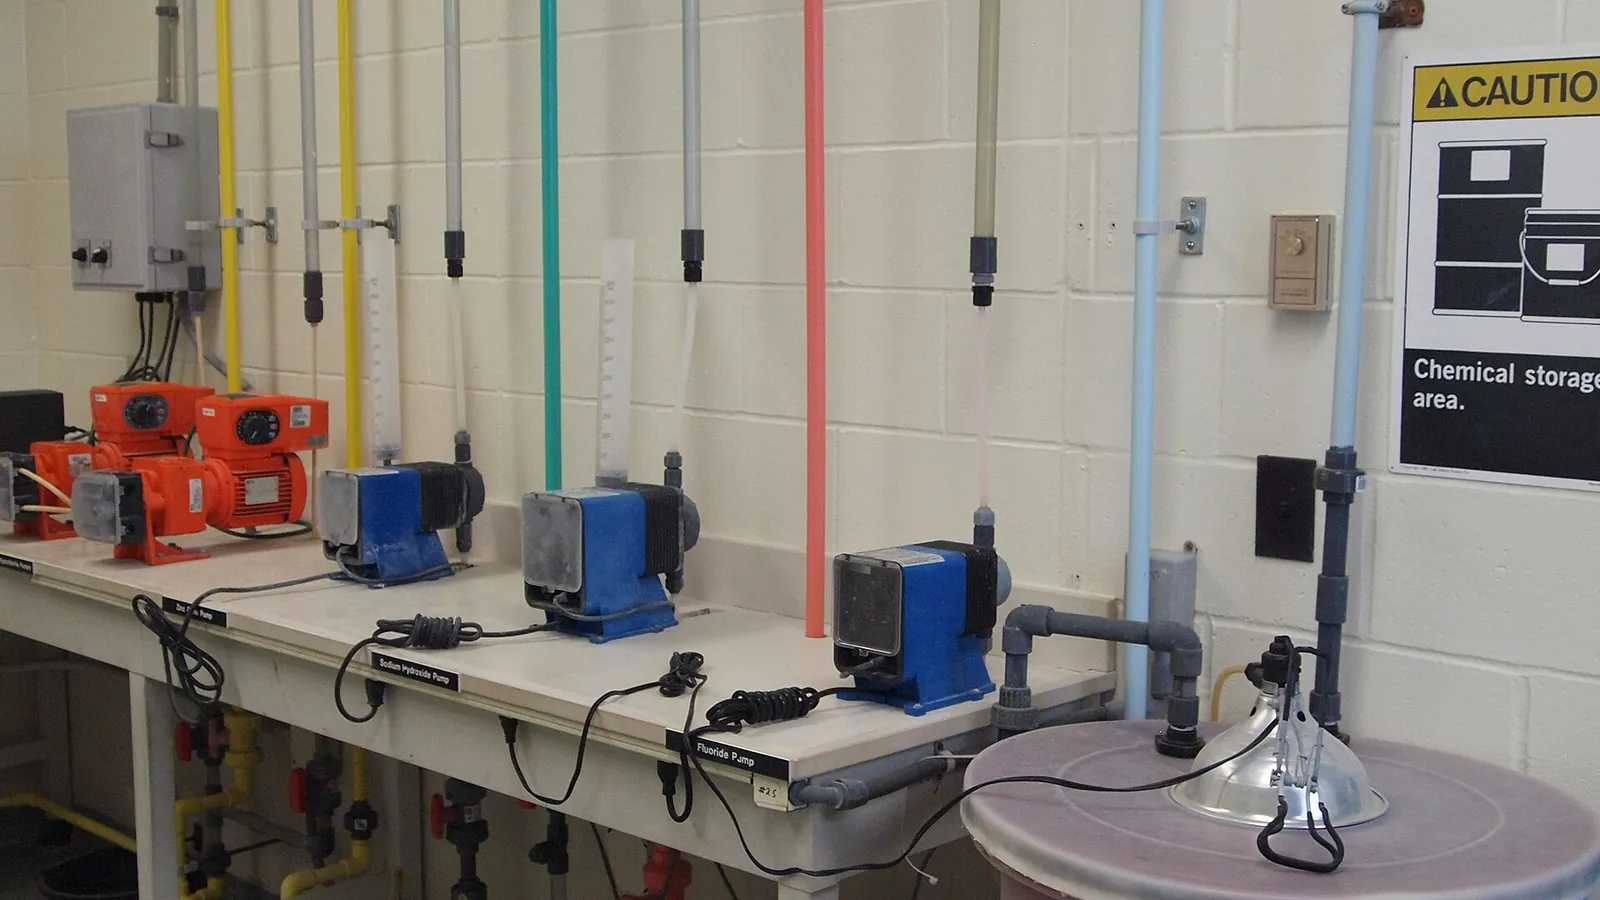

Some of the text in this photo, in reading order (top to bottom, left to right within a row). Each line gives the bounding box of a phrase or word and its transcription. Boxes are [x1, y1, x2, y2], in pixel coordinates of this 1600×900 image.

[1414, 358, 1515, 384] Chemical
[1413, 392, 1465, 410] area.
[380, 658, 449, 684] Sodium Hydroxide Pump
[697, 743, 729, 759] Fluoride
[758, 786, 777, 798] #25
